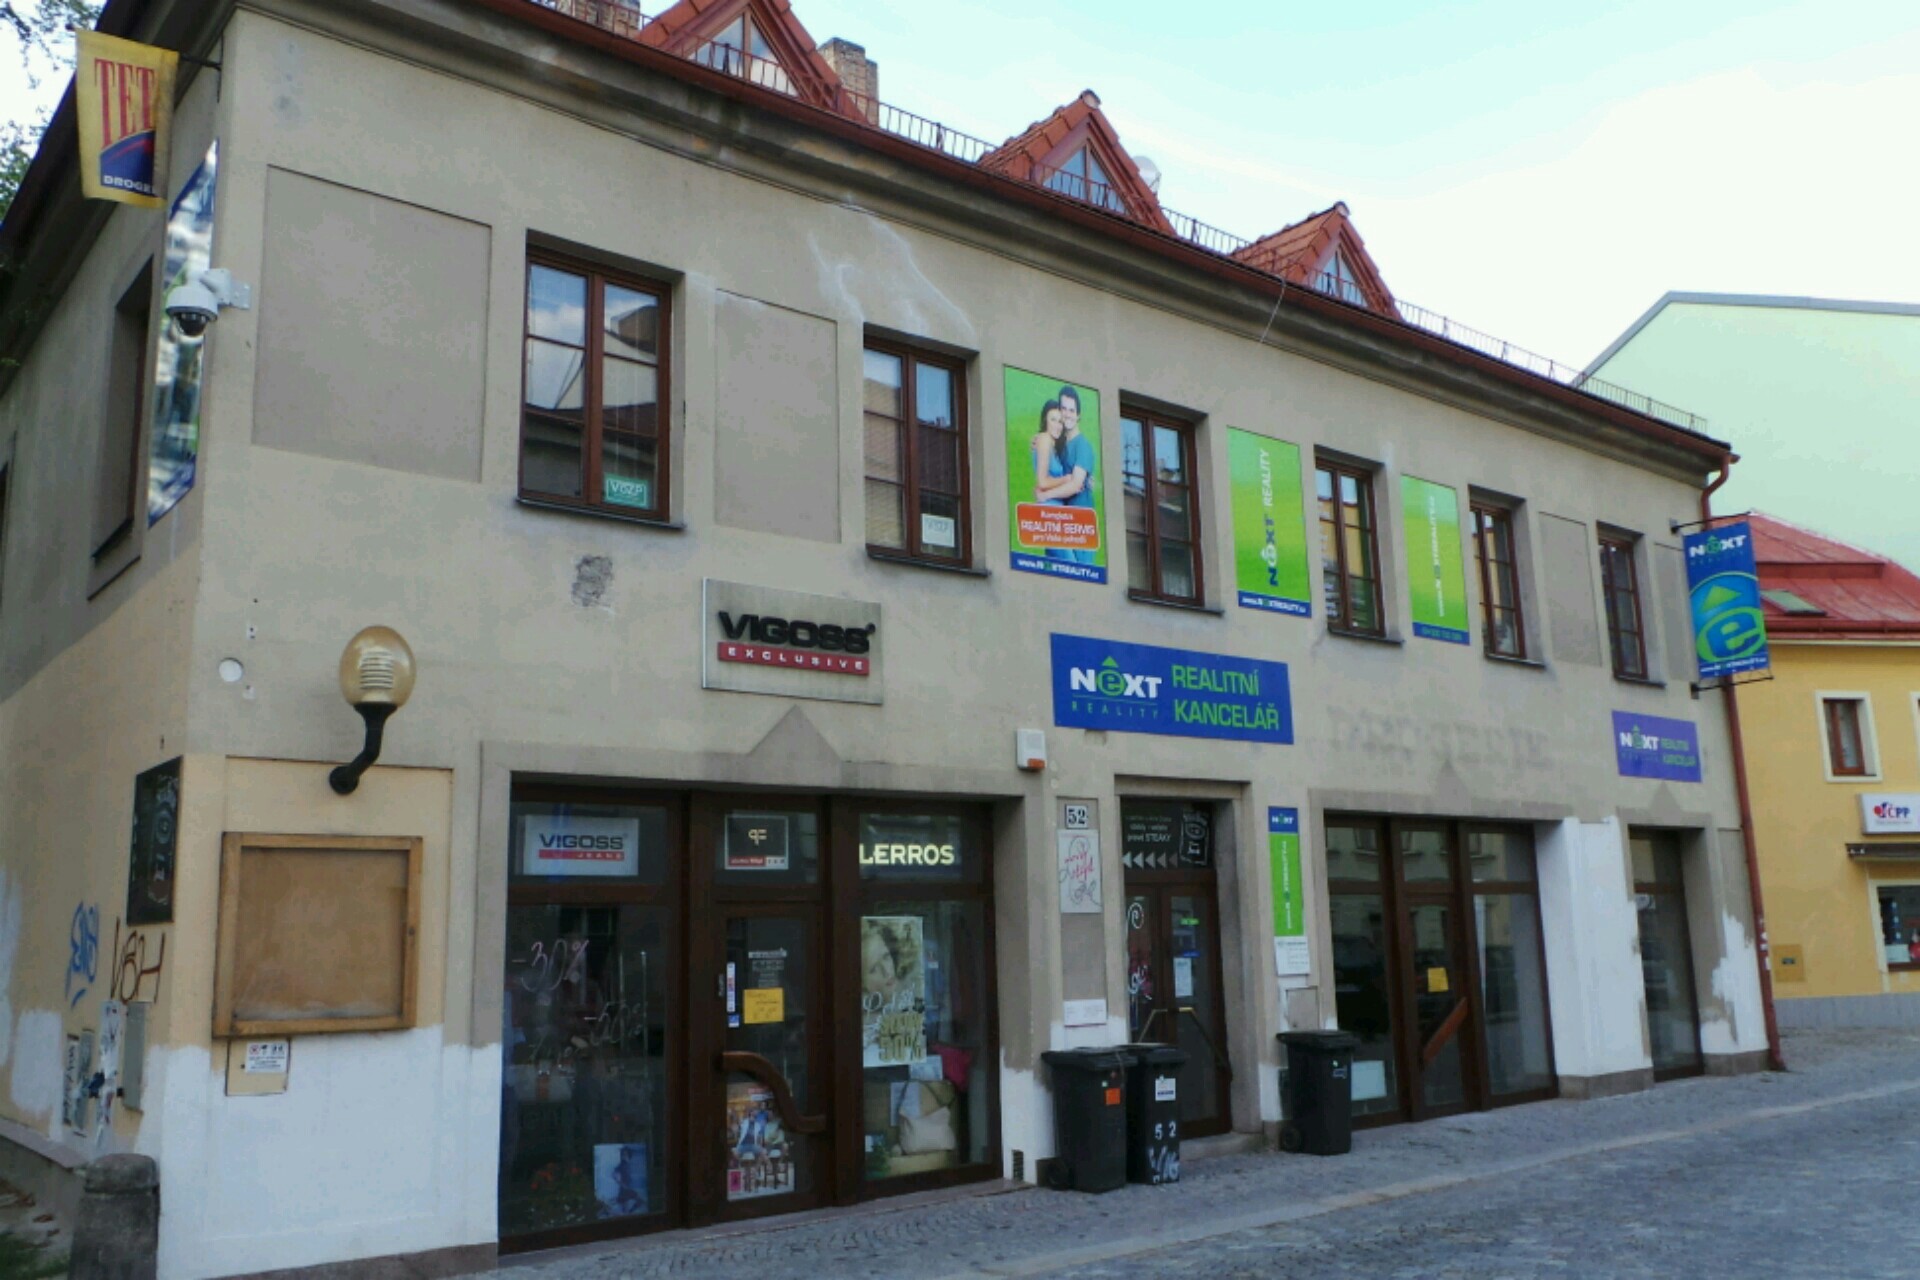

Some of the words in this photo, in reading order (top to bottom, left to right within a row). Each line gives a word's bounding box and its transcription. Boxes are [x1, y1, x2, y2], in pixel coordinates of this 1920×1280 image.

[94, 59, 154, 149] TET
[1259, 447, 1273, 507] REALITY
[718, 611, 871, 654] VIGOSS
[728, 646, 864, 671] EXCLUSIVE
[1171, 664, 1260, 696] REALITNÍ
[1072, 701, 1159, 720] REALITY
[1174, 698, 1280, 731] KANCELÁŘ
[1068, 808, 1088, 825] 52
[539, 833, 623, 850] VIGOSS
[859, 843, 955, 866] LERROS
